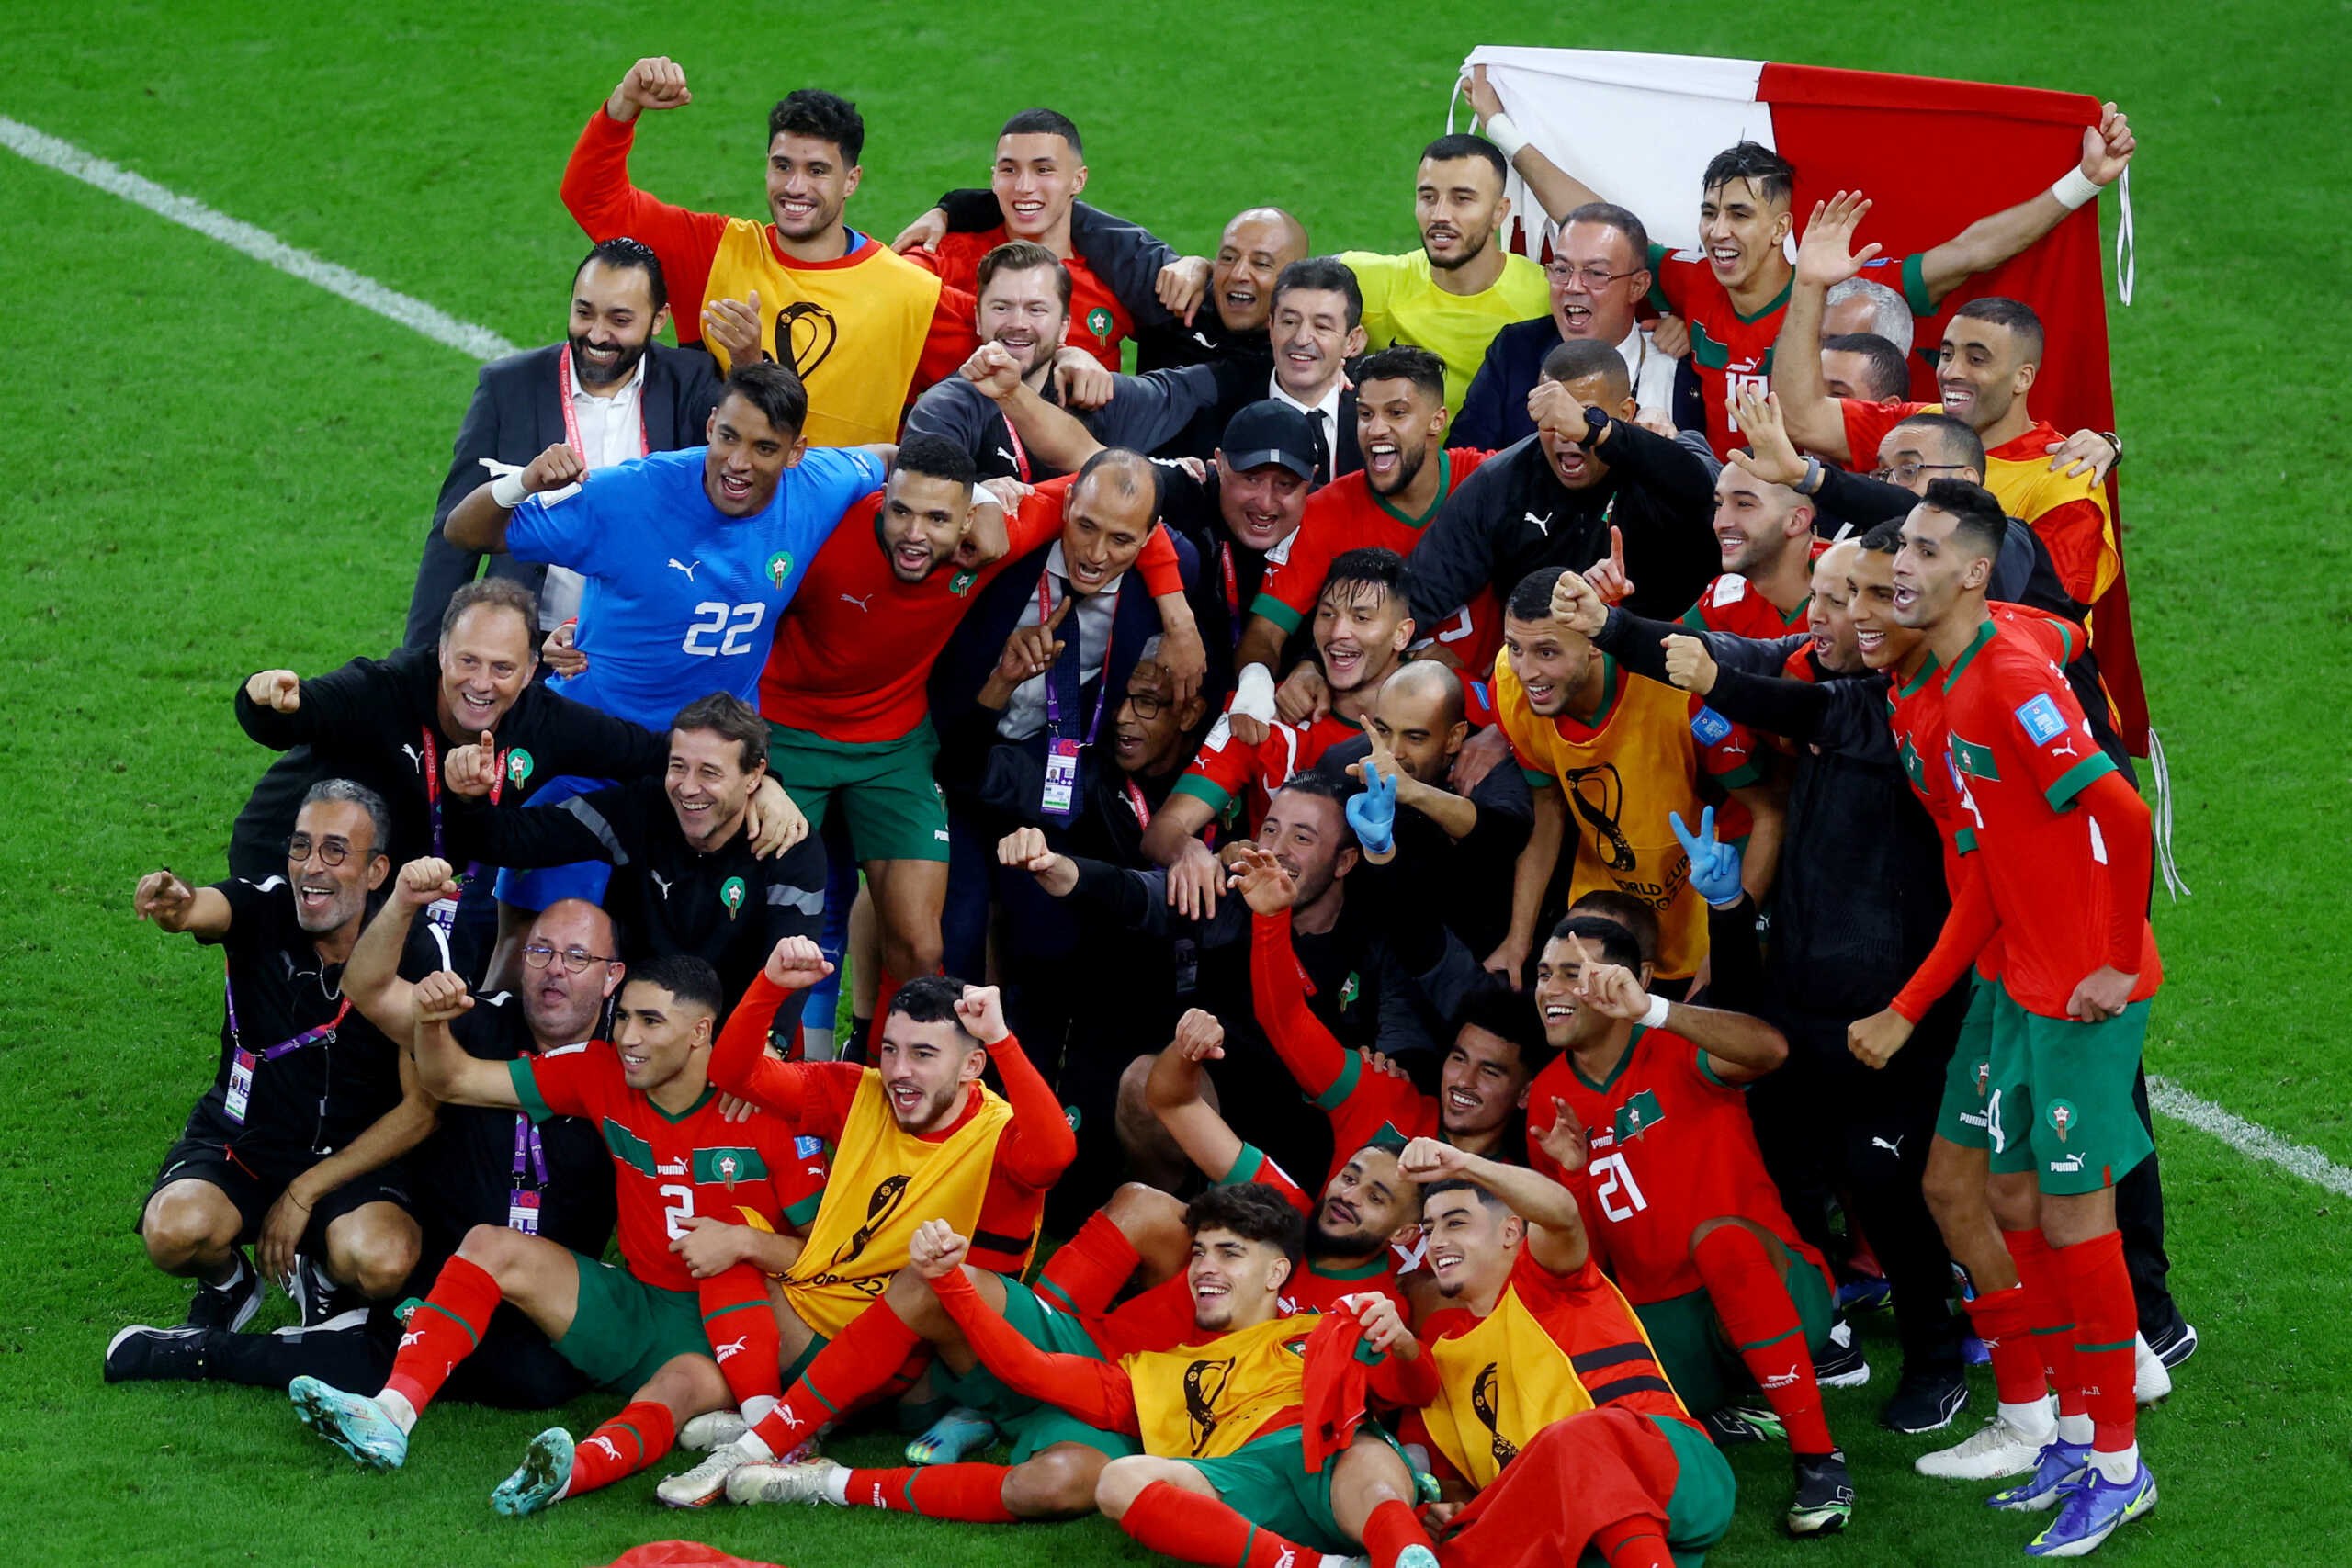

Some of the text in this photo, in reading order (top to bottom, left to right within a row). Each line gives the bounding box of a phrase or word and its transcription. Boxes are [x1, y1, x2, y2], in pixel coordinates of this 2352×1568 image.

[682, 601, 766, 657] 22
[1959, 1112, 1988, 1128] PUMA
[1987, 1089, 2006, 1155] 4
[657, 1164, 685, 1176] PUMA
[1589, 1152, 1648, 1223] 21
[2050, 1161, 2079, 1172] PUMA
[659, 1184, 695, 1241] 2
